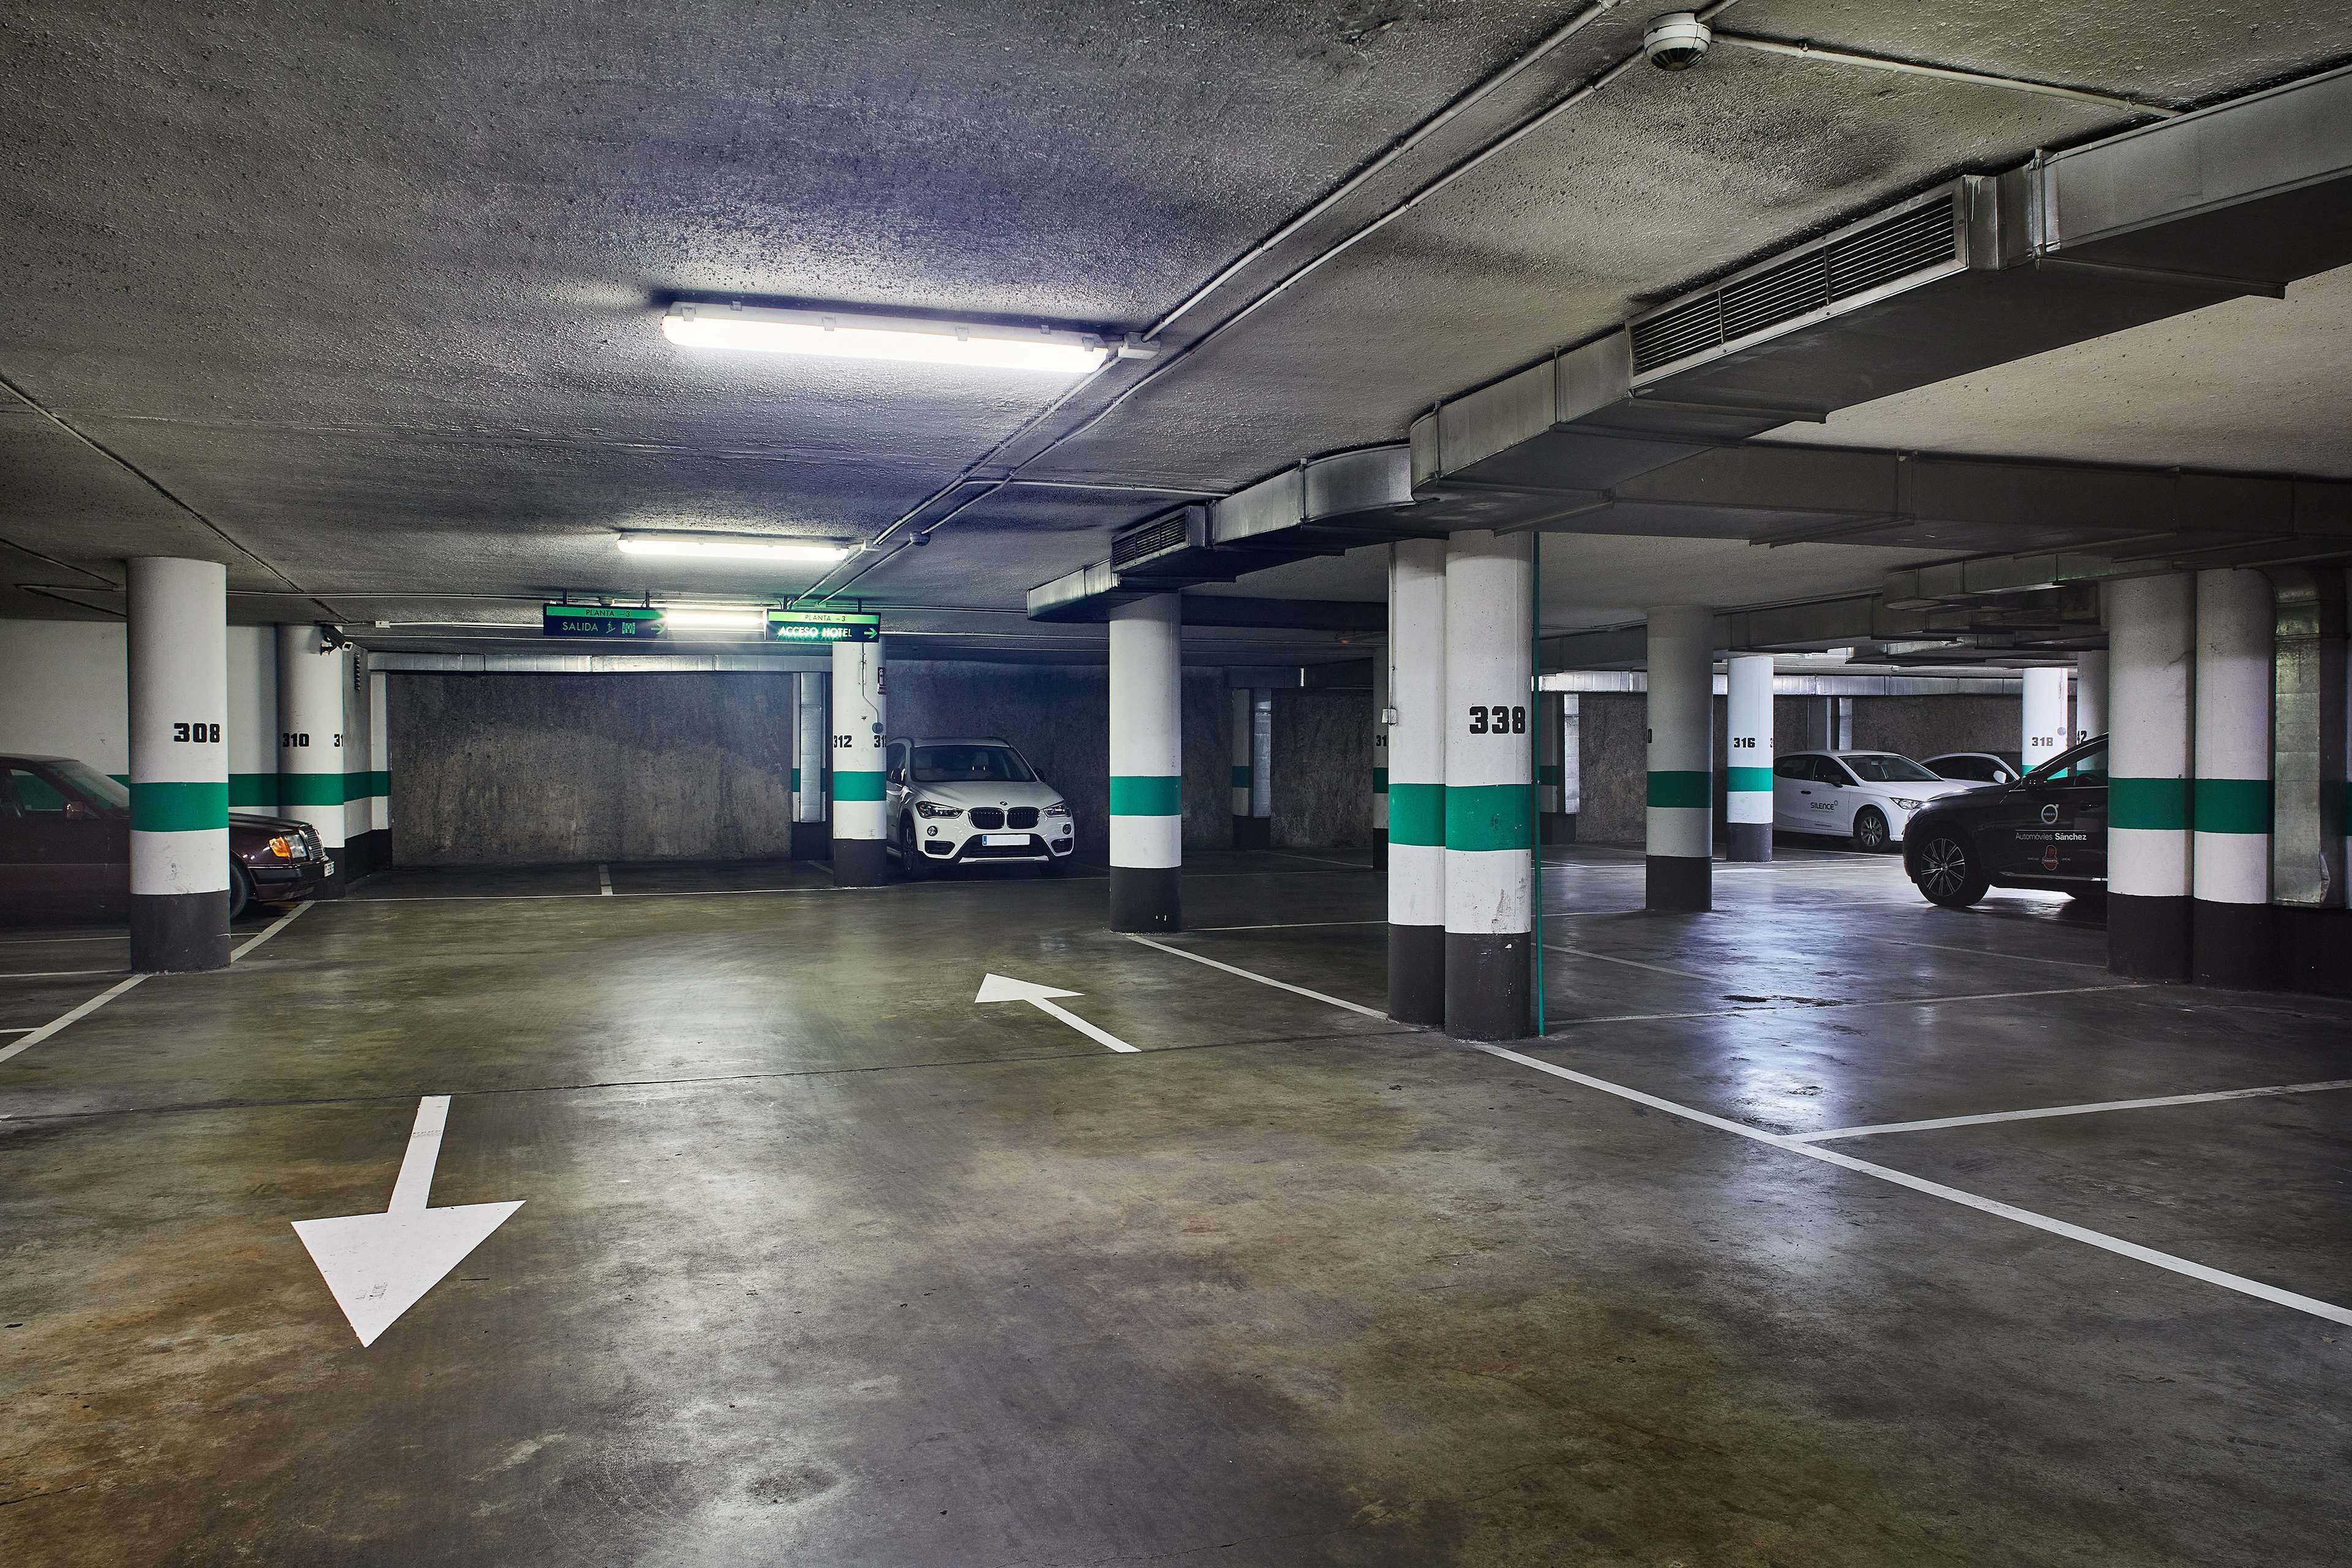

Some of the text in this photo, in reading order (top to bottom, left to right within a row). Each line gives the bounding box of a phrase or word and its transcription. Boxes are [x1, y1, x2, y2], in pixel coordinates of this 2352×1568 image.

[562, 622, 598, 631] SALIDA
[778, 626, 852, 638] ACCESO HOTEL
[1469, 706, 1526, 734] 338
[173, 723, 220, 743] 308
[282, 733, 309, 747] 310
[834, 735, 852, 748] 312
[1733, 737, 1755, 748] 316
[2031, 737, 2054, 747] 318
